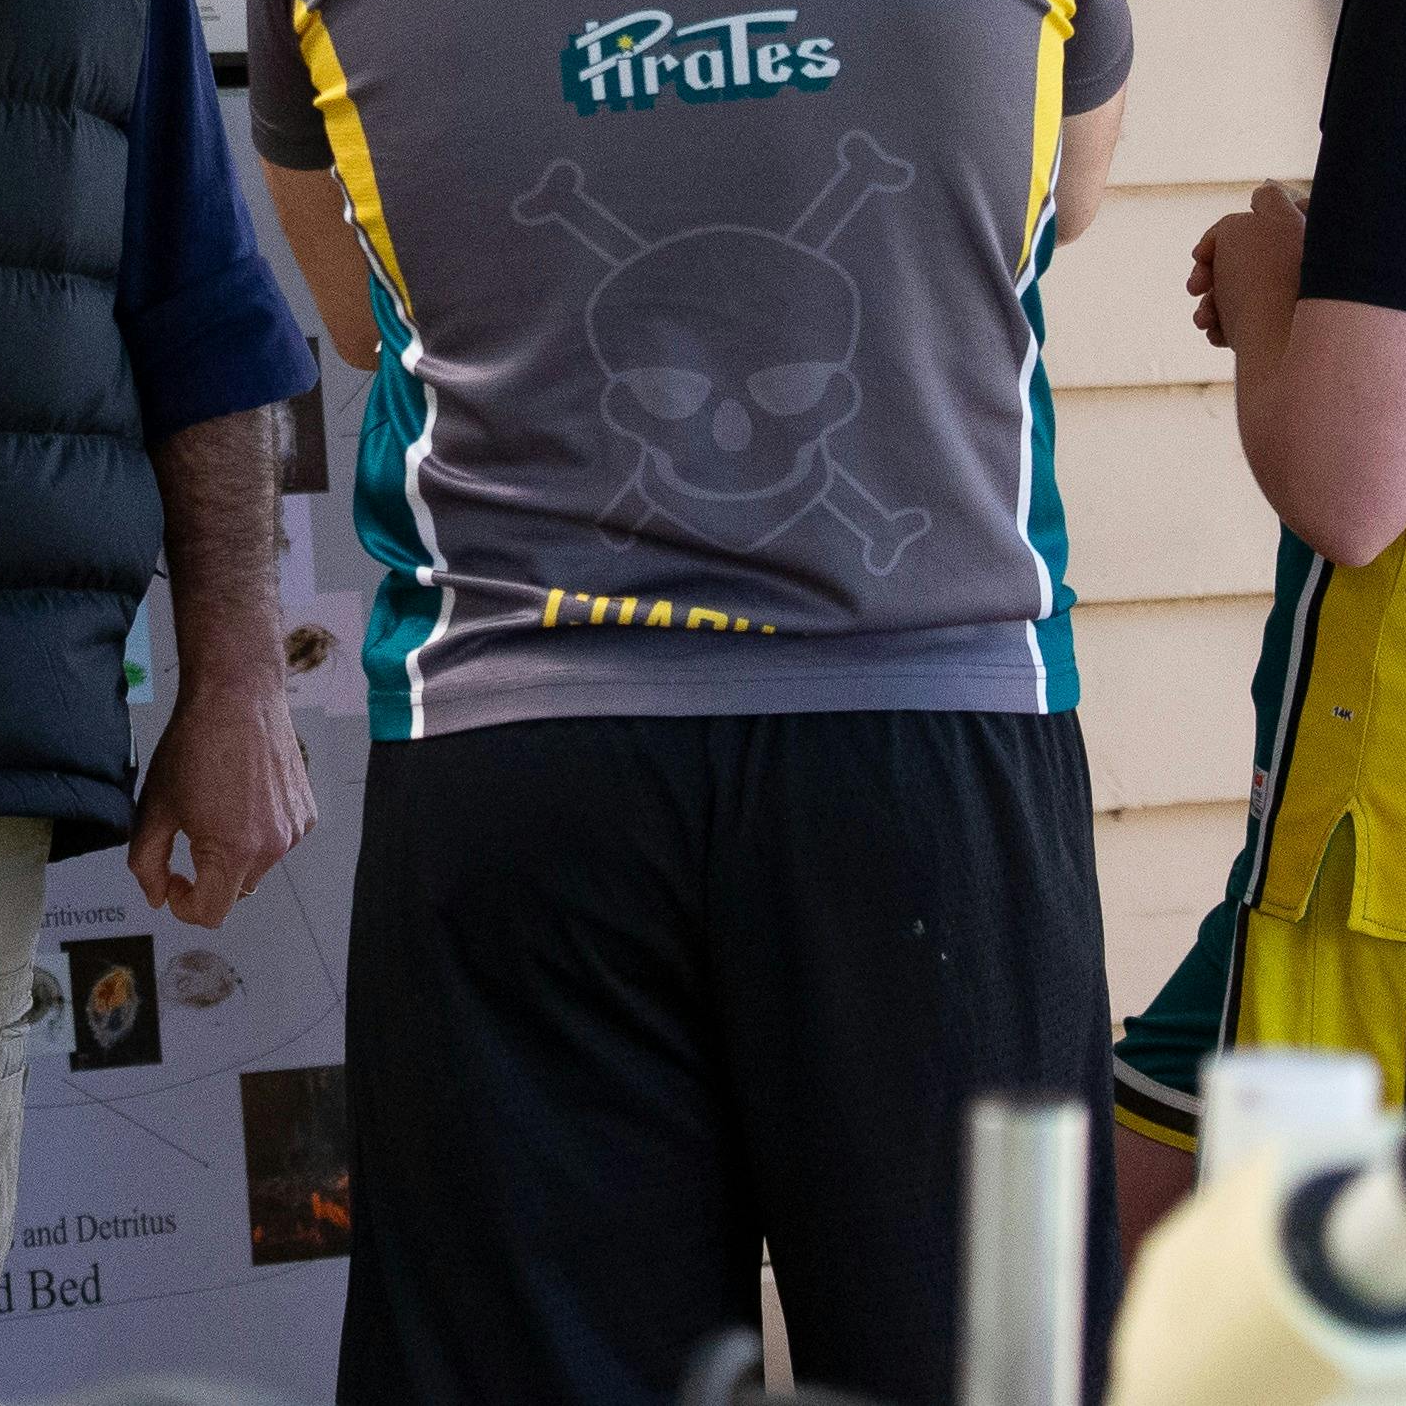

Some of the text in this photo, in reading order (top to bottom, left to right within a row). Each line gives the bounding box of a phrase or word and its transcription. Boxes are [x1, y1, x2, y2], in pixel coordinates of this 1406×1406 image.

[41, 903, 126, 928] ritivores
[23, 1209, 178, 1248] and Detritus
[29, 1263, 103, 1311] Bed
